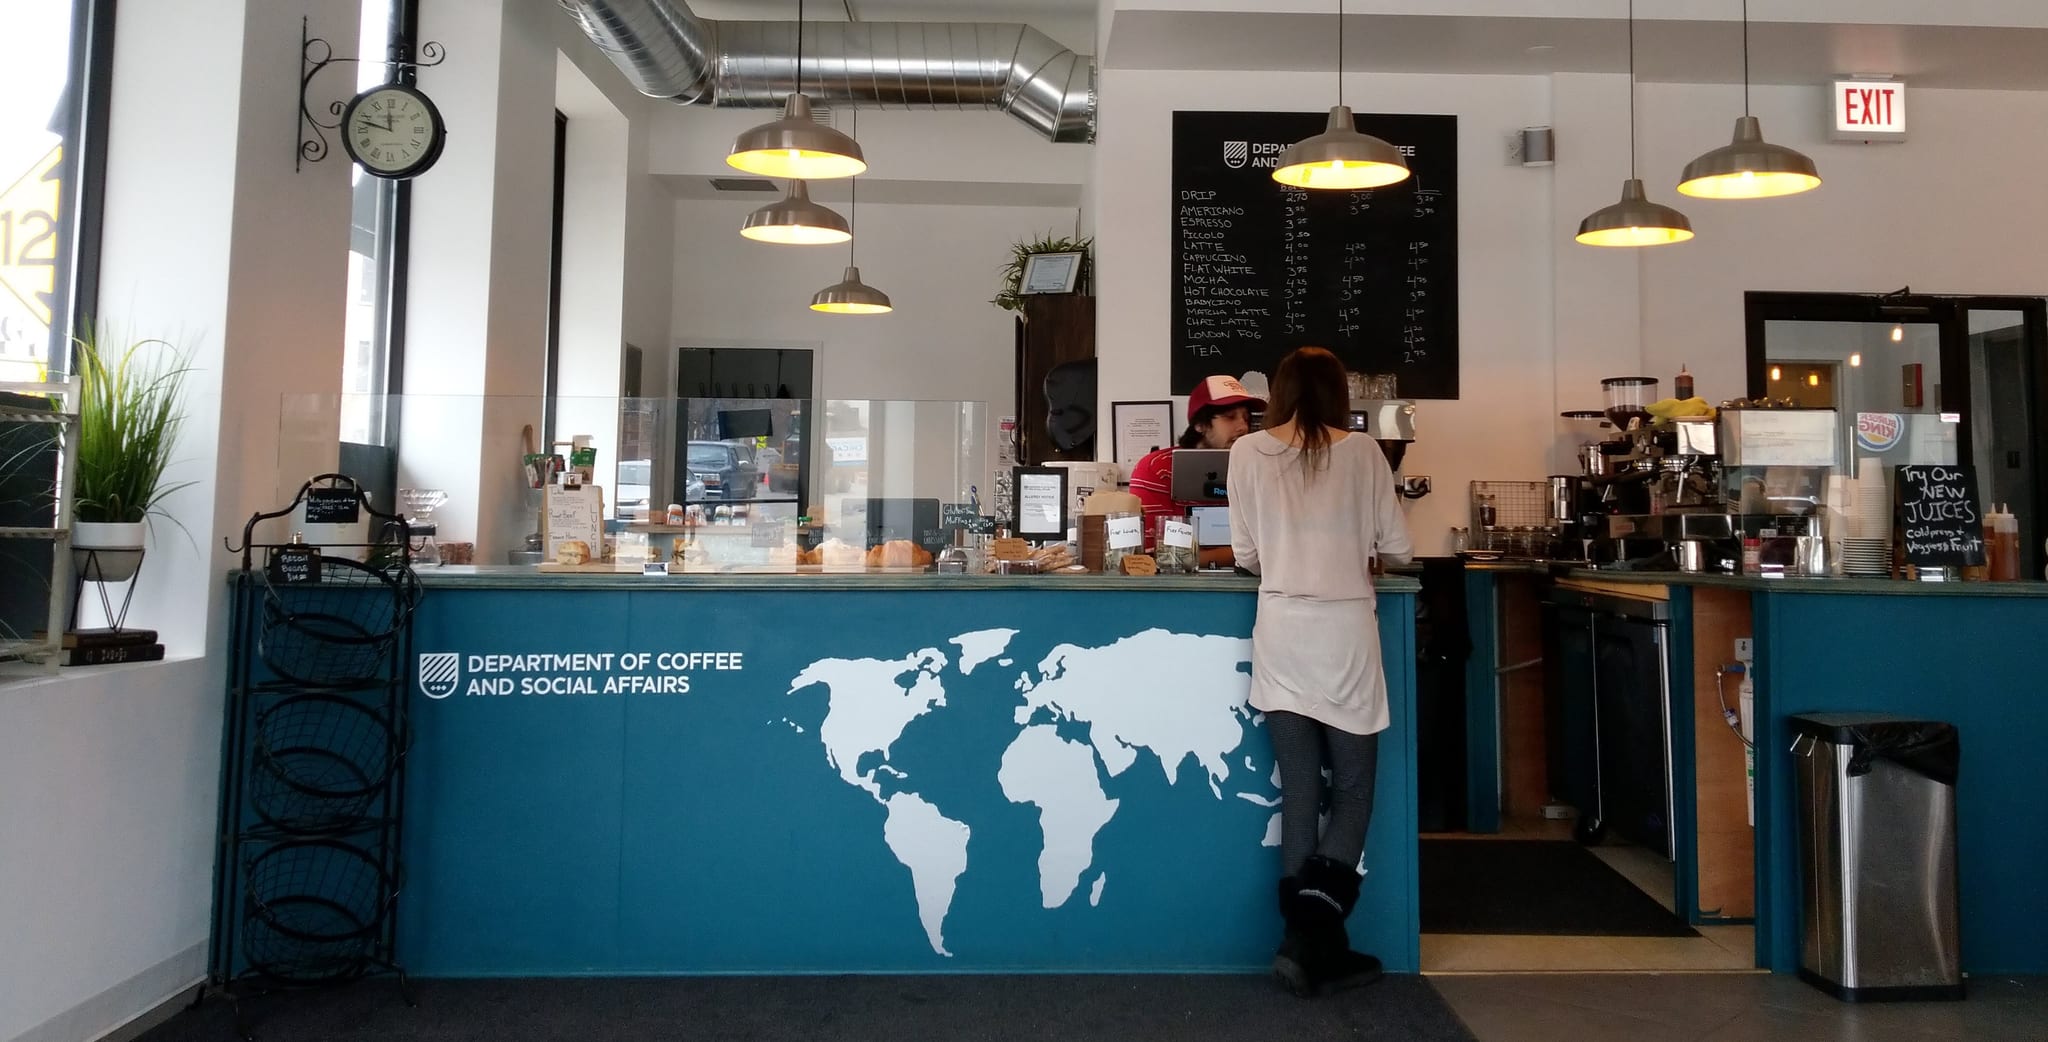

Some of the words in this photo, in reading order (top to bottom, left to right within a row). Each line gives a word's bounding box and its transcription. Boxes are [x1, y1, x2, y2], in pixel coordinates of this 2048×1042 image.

[1845, 88, 1894, 125] EXIT
[1181, 190, 1216, 200] DRIP
[1180, 205, 1244, 216] AMERICANO
[1180, 217, 1232, 228] ESPRESSO
[1, 209, 57, 266] 12
[1183, 228, 1224, 239] PICCOLO
[1183, 241, 1224, 251] LATTE
[1182, 252, 1247, 264] CAPPUCCINO
[1184, 263, 1210, 273] FLAT
[1212, 264, 1256, 275] WHITE
[1184, 274, 1229, 285] MOCHA
[1184, 286, 1206, 296] HOT
[1211, 287, 1269, 297] CHOCOLATE
[1234, 307, 1270, 316] LATTE
[1186, 317, 1215, 326] CHAI
[1221, 317, 1260, 328] LATTE
[1188, 328, 1230, 339] LONDON
[1237, 329, 1262, 339] FOG
[1184, 344, 1222, 357] TEA
[1900, 465, 1928, 487] Try
[1931, 467, 1963, 481] Our
[1919, 485, 1965, 500] NEW
[1904, 500, 1975, 523] JUICES
[1950, 536, 1982, 552] Fruit
[468, 653, 615, 673] DEPARTMENT
[620, 653, 650, 671] OF
[657, 652, 743, 670] COFFEE
[466, 678, 514, 696] AND
[521, 677, 598, 695] SOCIAL
[603, 675, 690, 694] AFFAIRS
